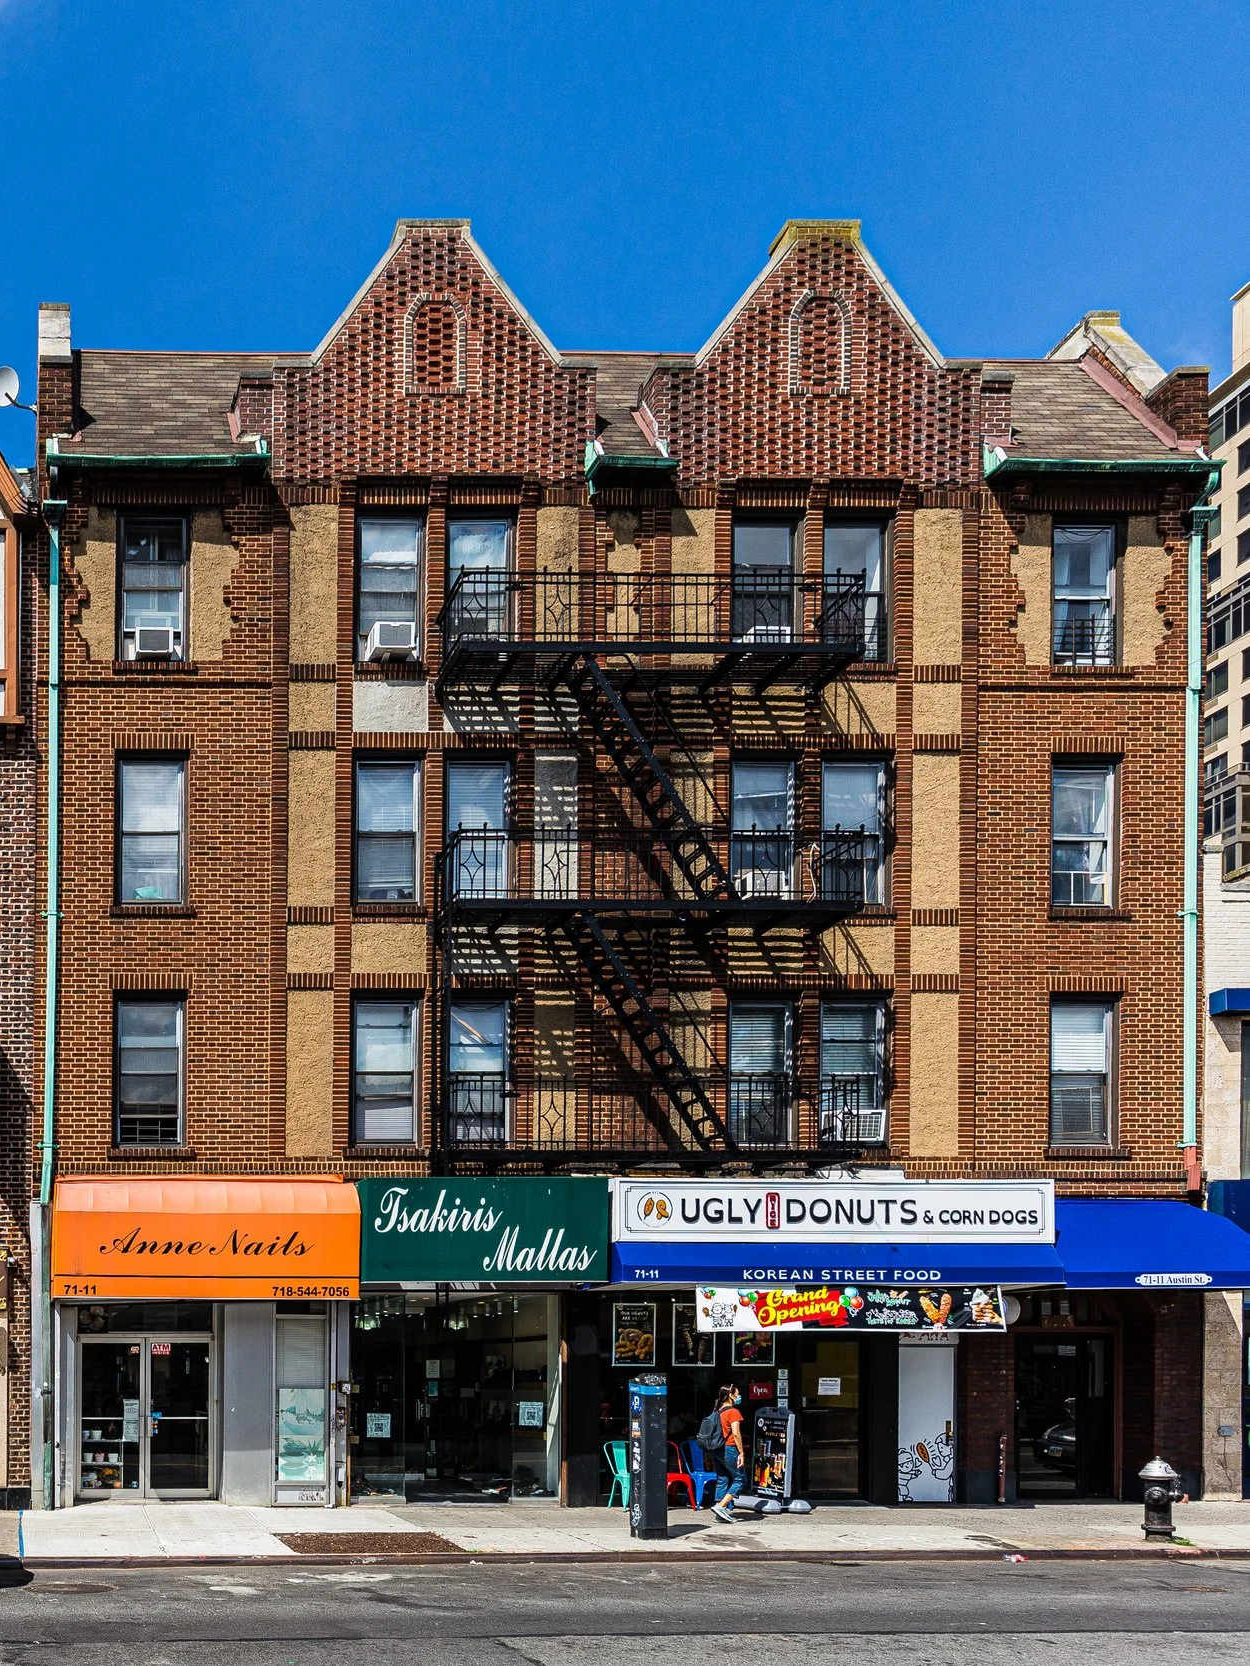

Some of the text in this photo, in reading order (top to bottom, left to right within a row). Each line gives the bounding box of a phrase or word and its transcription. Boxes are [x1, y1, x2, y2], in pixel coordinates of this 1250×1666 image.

[374, 1186, 503, 1233] Tsakiris
[681, 1198, 763, 1224] UGLY
[786, 1198, 918, 1224] DONUTS
[923, 1210, 934, 1224] &
[938, 1210, 984, 1224] CORN
[989, 1210, 1039, 1224] DOGS
[100, 1227, 315, 1256] Anne Nails
[483, 1224, 598, 1271] Mallas
[635, 1269, 941, 1280] 71-11 KOREAN STREET FOOD
[1144, 1275, 1205, 1284] 71-11 Austin St.
[63, 1285, 350, 1297] 71-11 718-544-7056
[766, 1286, 830, 1307] Grand
[758, 1301, 840, 1326] Opening
[152, 1343, 170, 1351] ATM
[753, 1386, 768, 1396] Open
